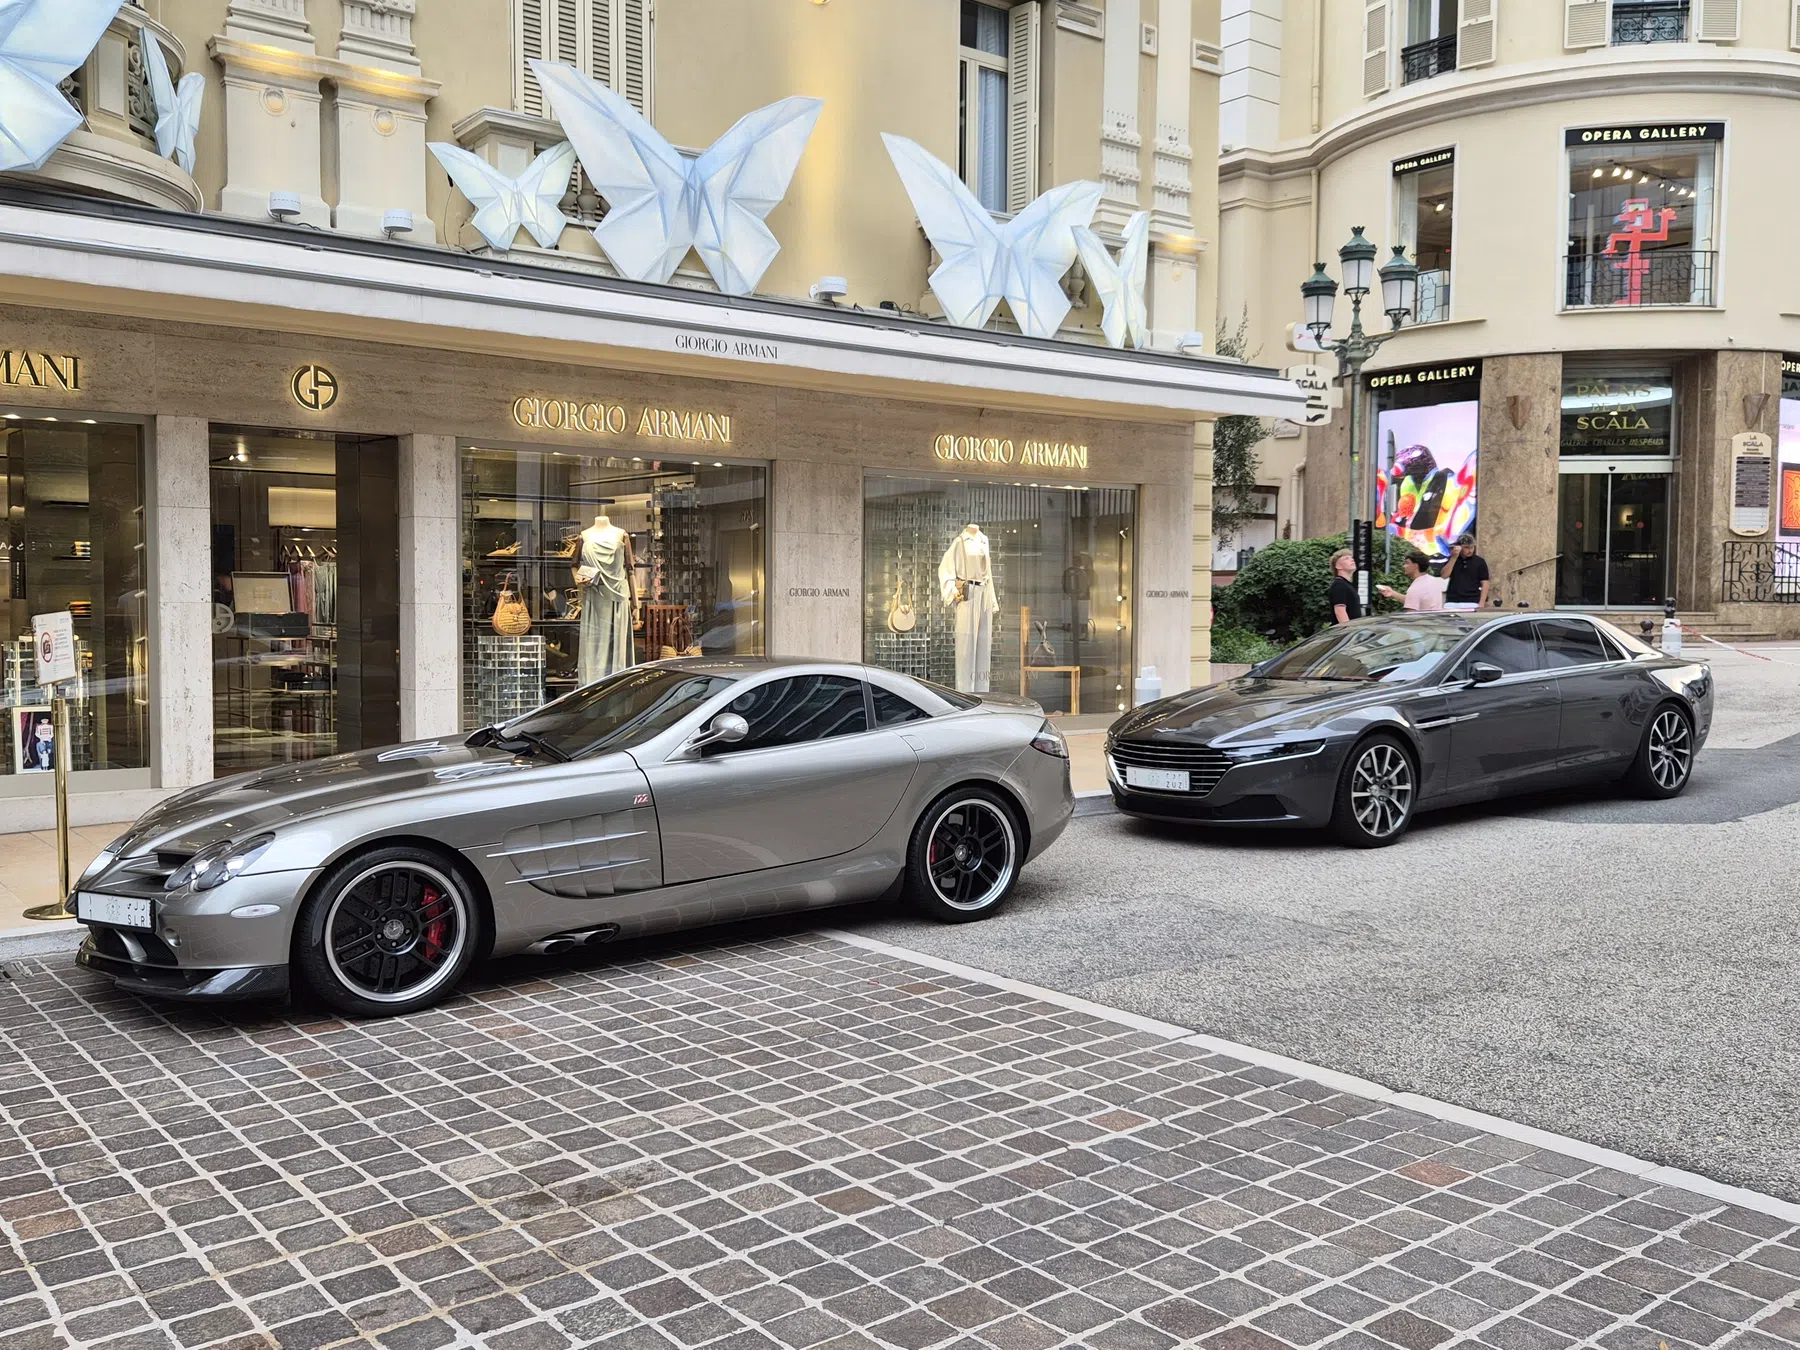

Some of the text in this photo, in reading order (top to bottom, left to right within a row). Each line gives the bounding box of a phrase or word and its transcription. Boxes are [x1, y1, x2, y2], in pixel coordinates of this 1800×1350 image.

[1581, 126, 1707, 142] OPERA GALLERY
[1395, 152, 1452, 172] OPERA GALLERY
[675, 334, 778, 359] GIORGIO ARMANI
[1306, 368, 1317, 377] LA
[1370, 365, 1476, 388] OPERA GALLERY
[1576, 383, 1651, 398] PALAIS
[1591, 402, 1637, 413] DE LA
[512, 396, 733, 443] GIORGIO ARMANI
[1576, 416, 1650, 430] SCALA
[934, 434, 1089, 469] GIORGIO ARMANI
[789, 587, 850, 597] GIORGIO ARMANI
[1146, 590, 1189, 598] GIORGIO ARMANI
[1008, 670, 1040, 681] ARANI
[1165, 780, 1183, 789] ZUZ
[632, 793, 649, 805] 722
[127, 914, 146, 926] SLR
